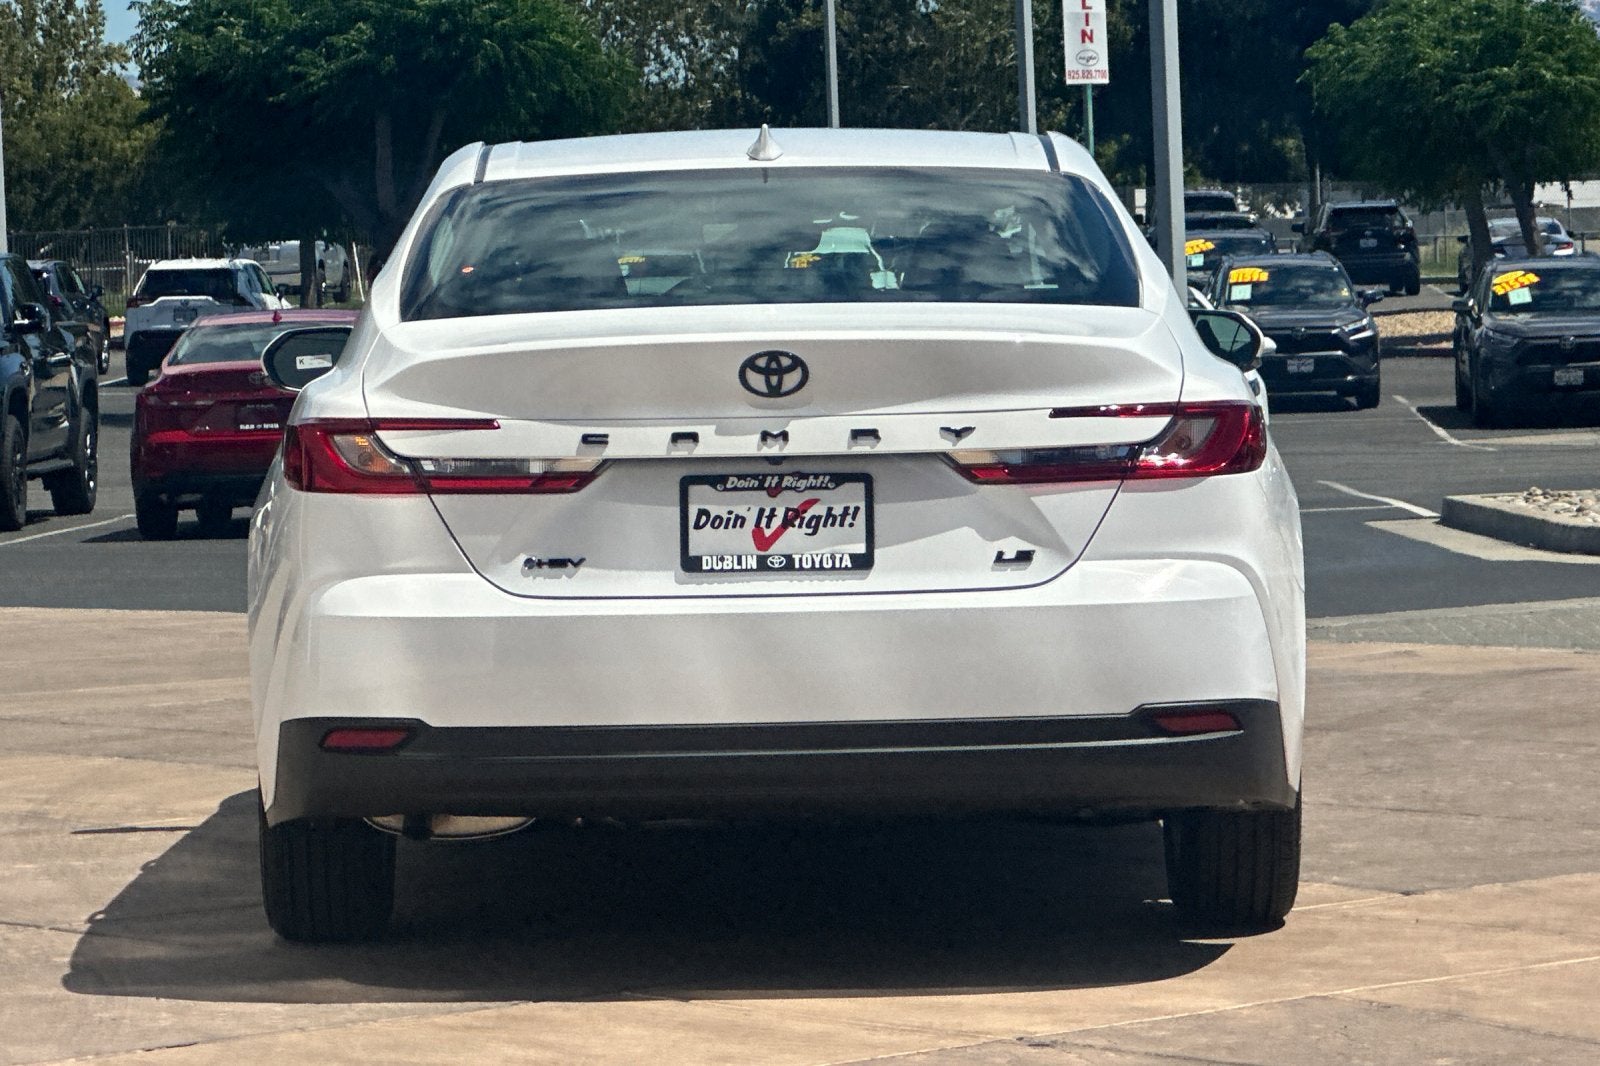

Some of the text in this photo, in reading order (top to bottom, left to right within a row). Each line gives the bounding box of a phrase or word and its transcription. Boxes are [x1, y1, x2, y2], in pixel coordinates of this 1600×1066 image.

[581, 426, 977, 446] CAMRY
[726, 475, 829, 490] Doin' It Right!
[693, 505, 861, 536] Doin' It Right!
[702, 553, 853, 570] DUBLIN TOYOTA
